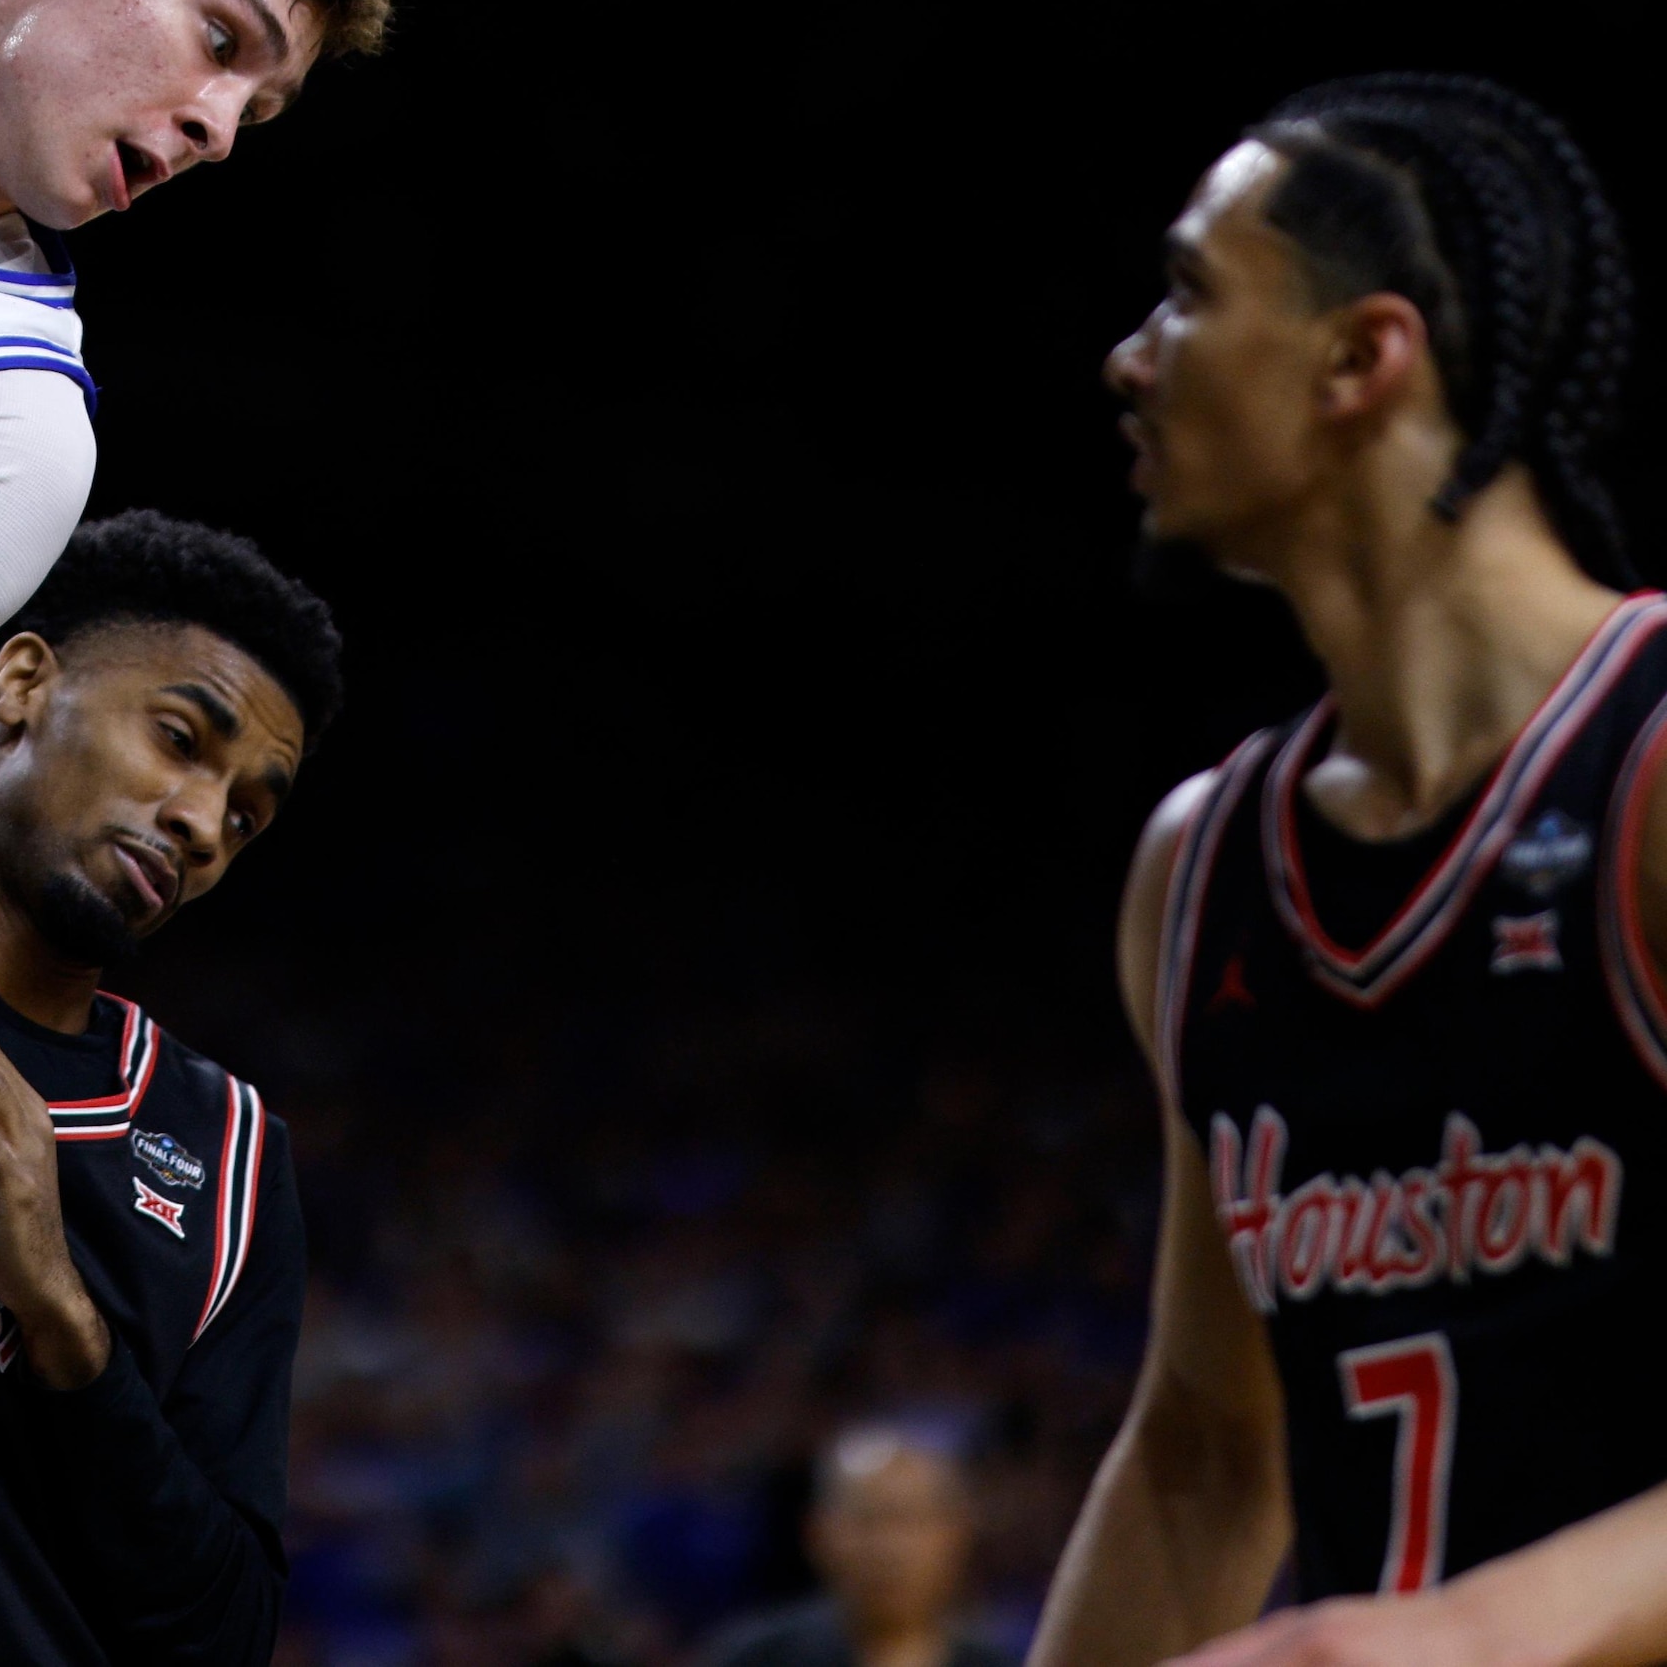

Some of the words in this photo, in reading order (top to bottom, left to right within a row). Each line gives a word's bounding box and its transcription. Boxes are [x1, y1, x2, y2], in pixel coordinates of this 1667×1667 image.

[136, 1138, 169, 1162] FINAL
[168, 1154, 202, 1178] FOUR
[1209, 1104, 1624, 1315] Houston
[1336, 1332, 1458, 1596] 7
